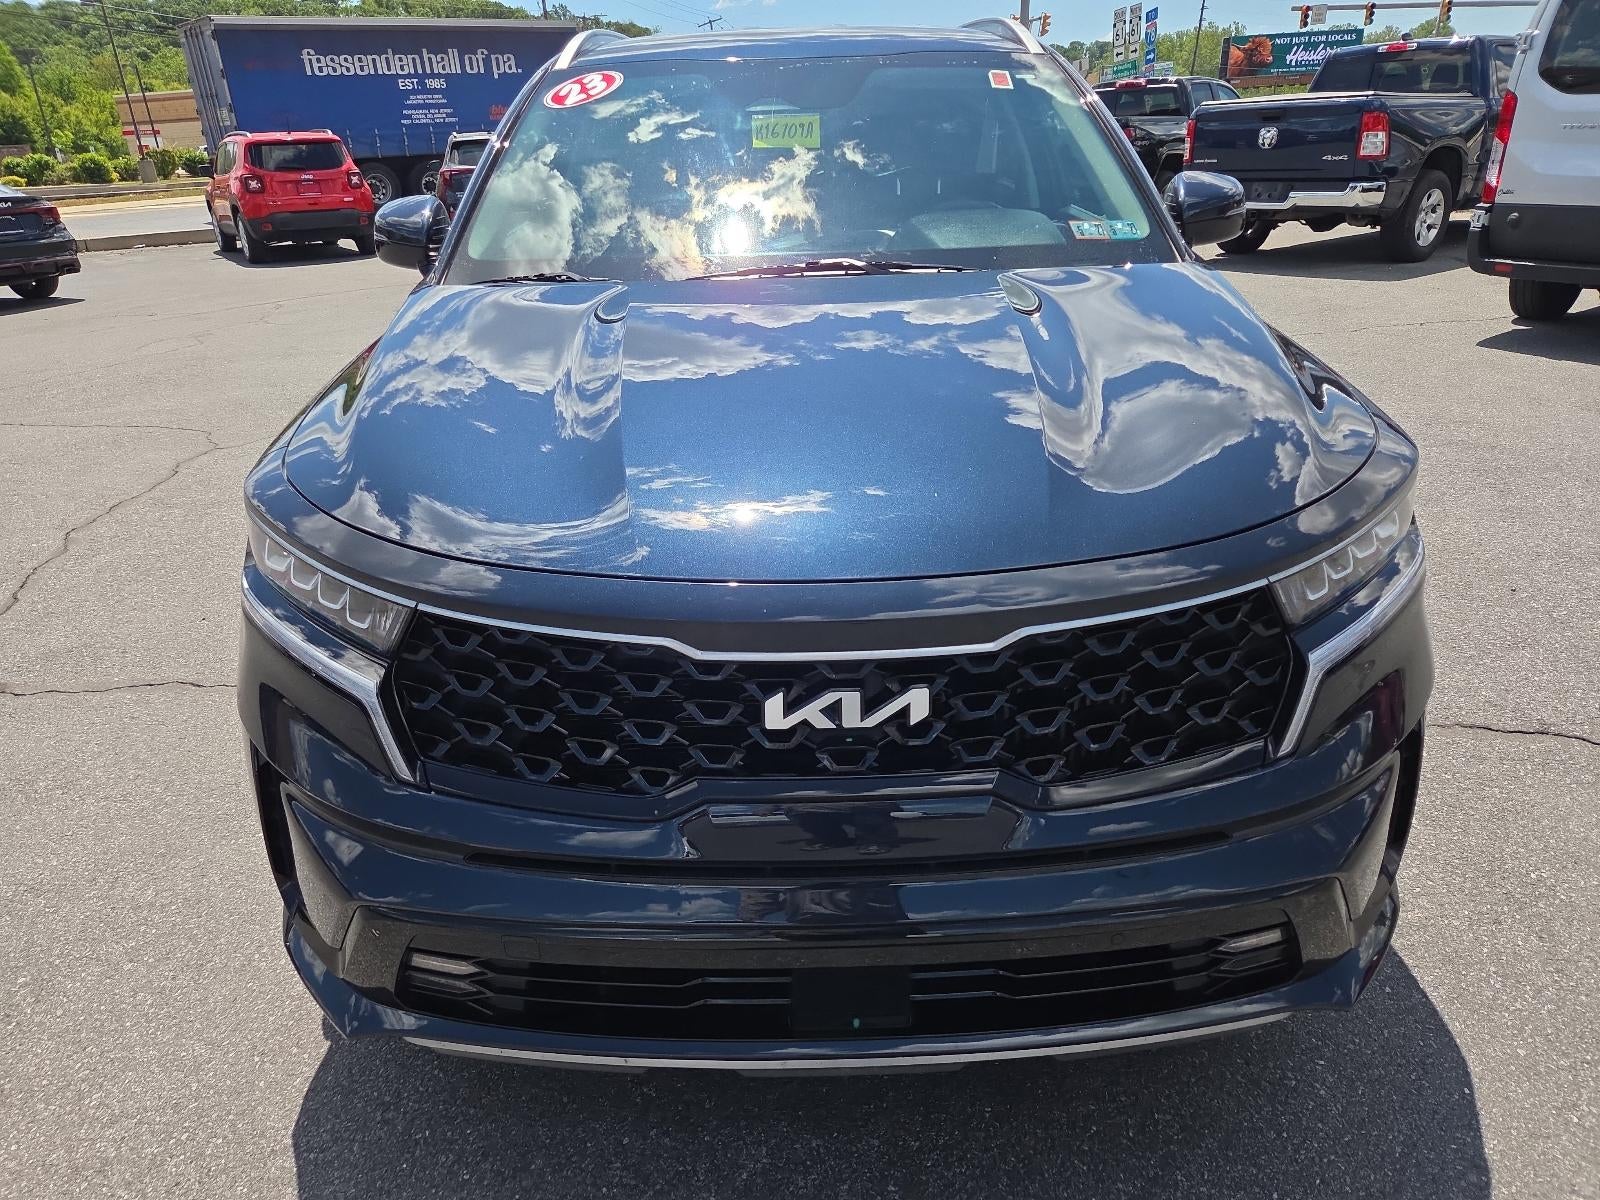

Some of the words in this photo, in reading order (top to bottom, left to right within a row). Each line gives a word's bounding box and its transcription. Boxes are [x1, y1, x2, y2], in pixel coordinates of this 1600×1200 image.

[1115, 27, 1124, 41] 61
[1131, 22, 1139, 36] 61
[1147, 28, 1156, 42] 78
[1292, 36, 1310, 44] JUST
[1328, 33, 1357, 41] LOCALS
[301, 48, 422, 76] fessenden
[422, 48, 461, 74] hall
[464, 48, 488, 74] of
[491, 53, 522, 79] pa.
[398, 79, 421, 90] EST.
[424, 78, 447, 89] 1985
[558, 73, 608, 105] 23
[764, 691, 930, 730] KIA
